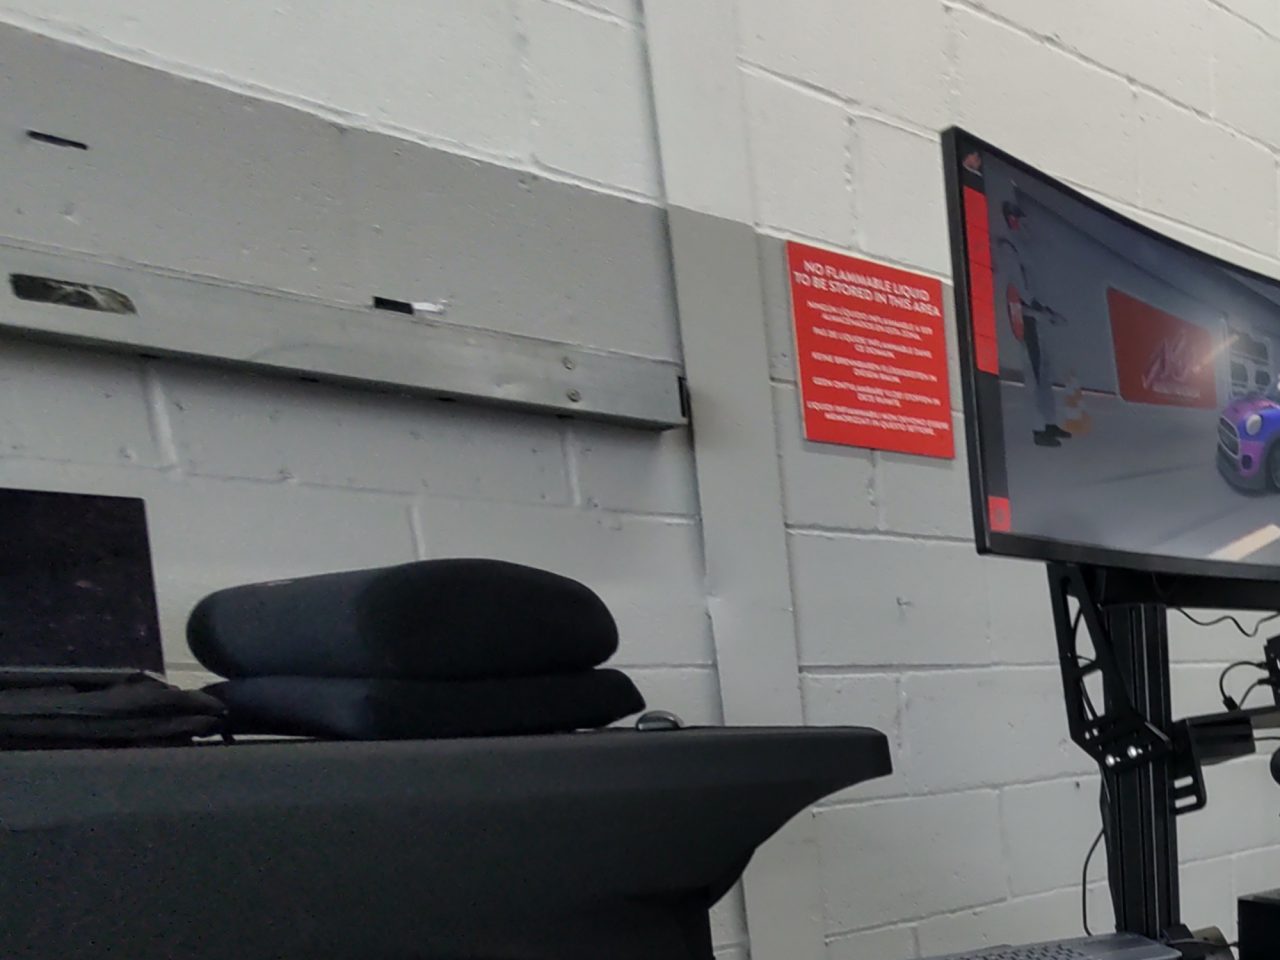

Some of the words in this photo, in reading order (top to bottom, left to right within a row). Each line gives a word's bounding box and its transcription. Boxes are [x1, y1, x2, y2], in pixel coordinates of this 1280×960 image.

[793, 271, 811, 287] TO
[811, 275, 828, 292] BE
[828, 279, 874, 302] STORED
[874, 290, 888, 305] IN
[887, 293, 912, 311] THIS
[912, 300, 942, 317] AREA
[803, 260, 825, 276] NO
[825, 265, 892, 293] FLAMMABLE
[892, 282, 931, 302] LIQUID
